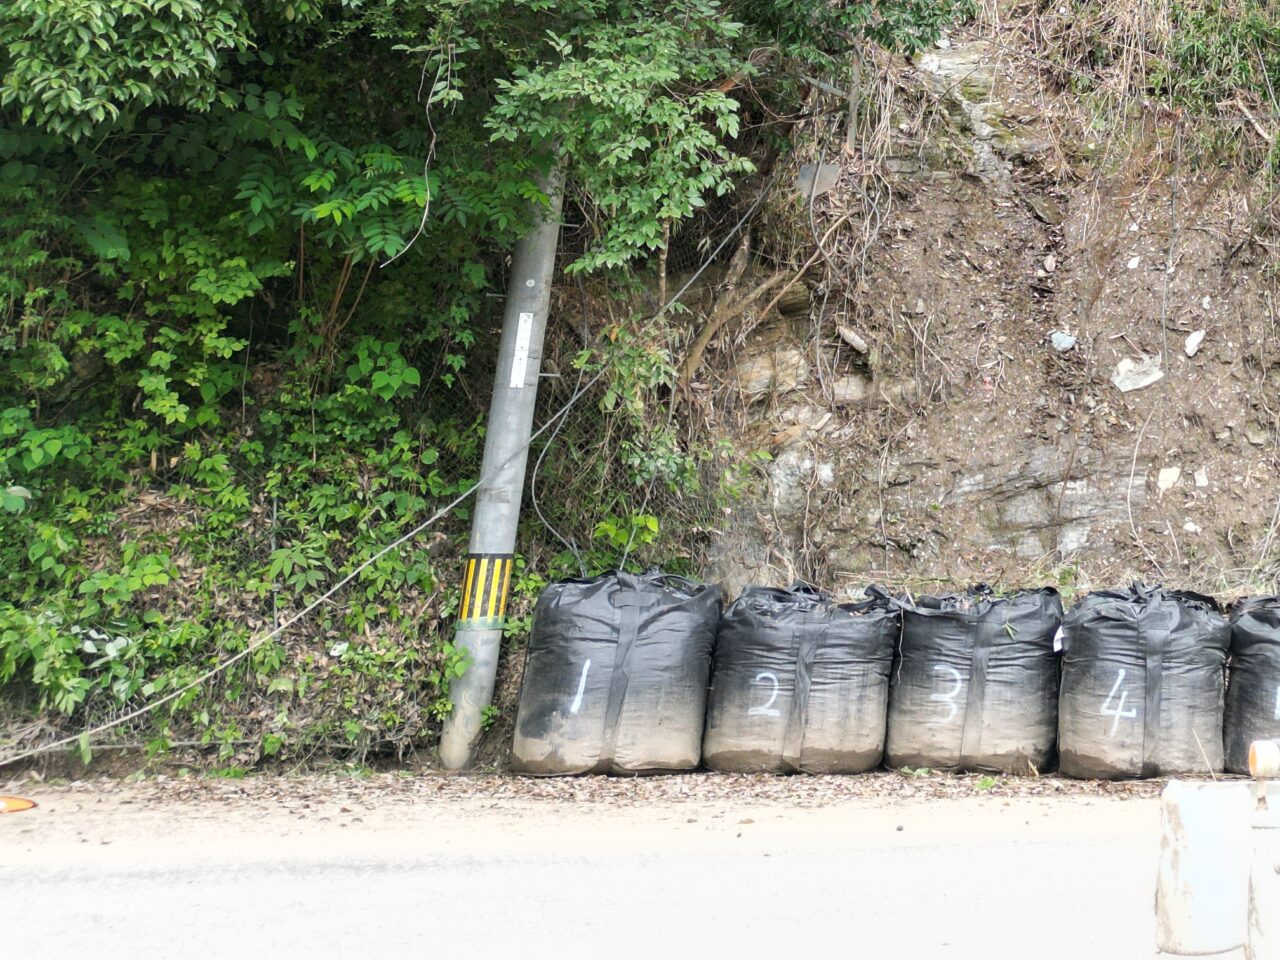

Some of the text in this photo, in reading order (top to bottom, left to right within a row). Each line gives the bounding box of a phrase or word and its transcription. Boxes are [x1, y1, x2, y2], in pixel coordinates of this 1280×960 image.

[570, 658, 591, 714] 1
[748, 672, 781, 717] 2
[928, 664, 962, 726] 3
[1100, 668, 1137, 737] 4
